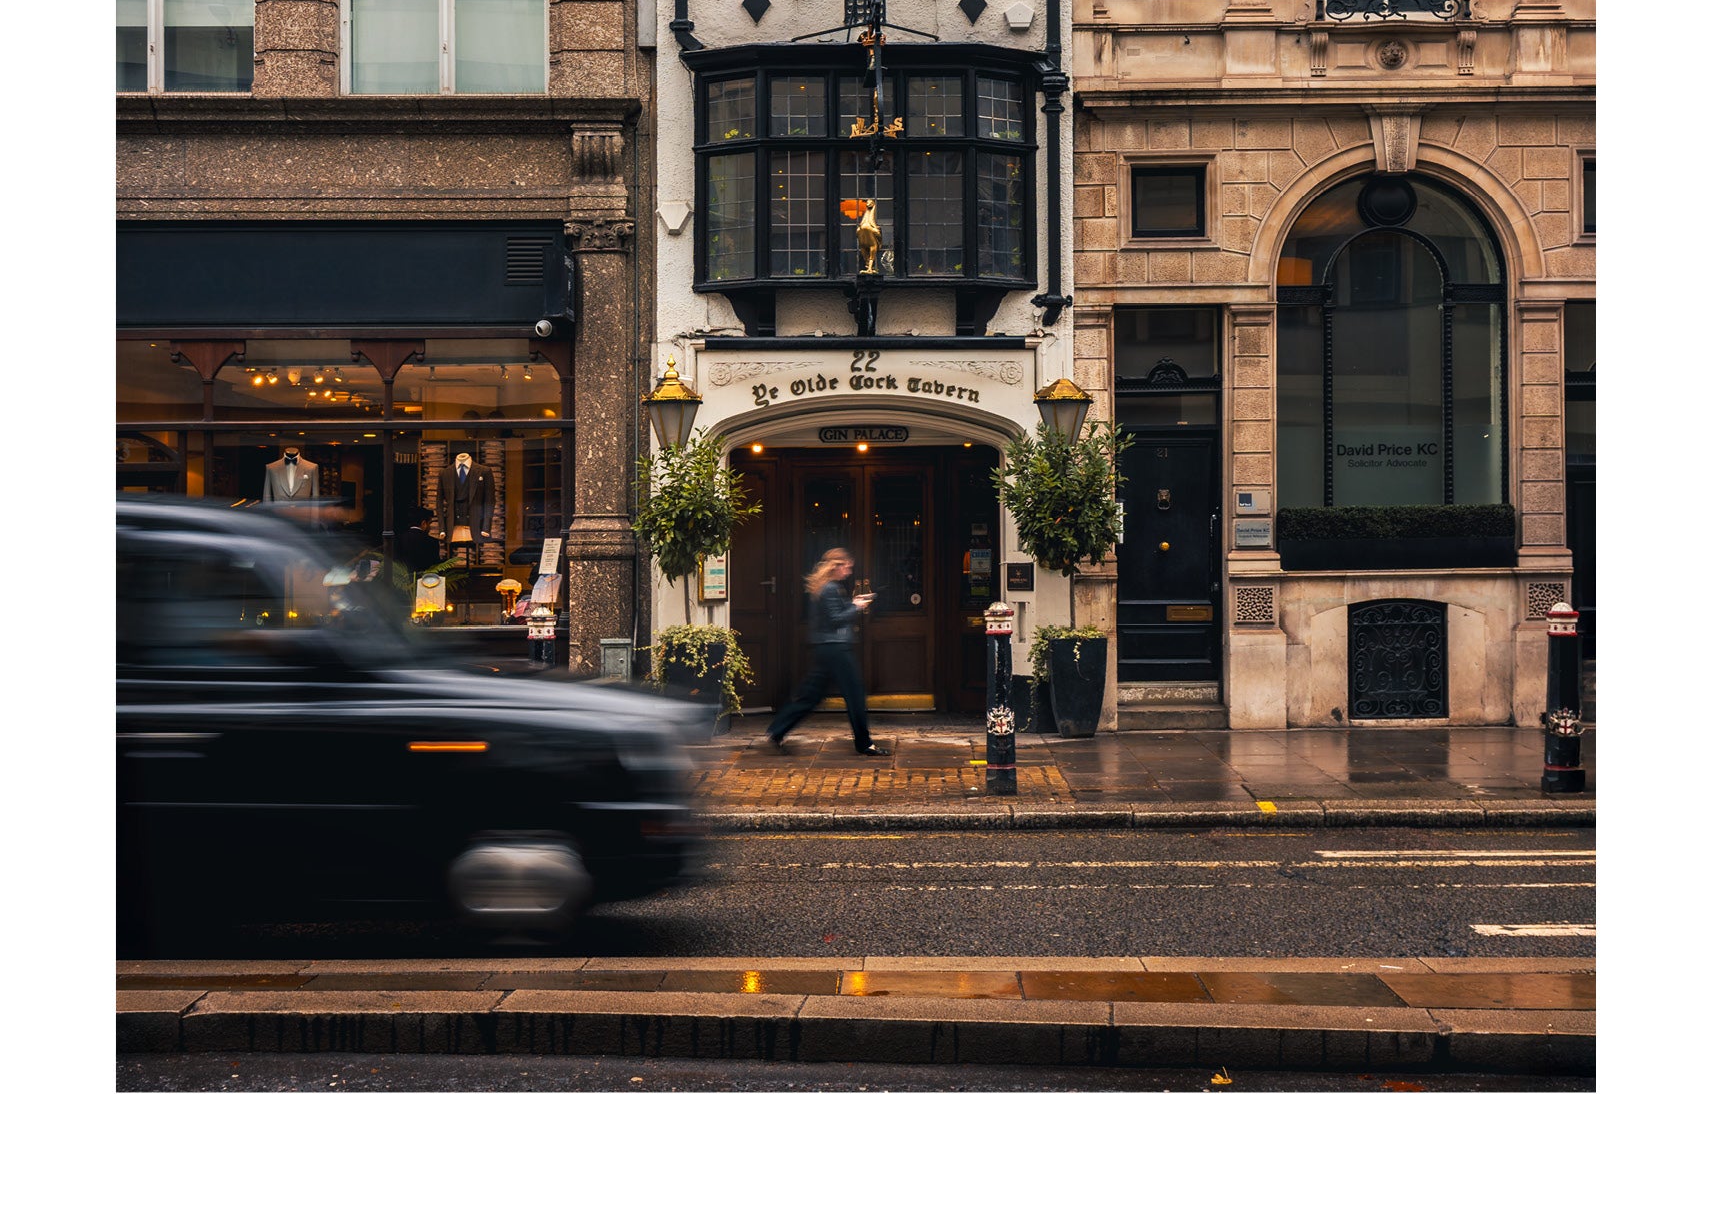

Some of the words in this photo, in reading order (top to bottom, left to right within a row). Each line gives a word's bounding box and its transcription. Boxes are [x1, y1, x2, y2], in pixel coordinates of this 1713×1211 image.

[850, 350, 880, 372] 22
[752, 383, 779, 407] Ye
[790, 373, 839, 396] Olde
[849, 374, 898, 390] Cock
[907, 377, 980, 403] Tavern
[823, 429, 848, 440] GIN
[854, 428, 904, 440] PALACE
[1336, 444, 1374, 456] David
[1378, 443, 1412, 456] Price
[1417, 443, 1438, 456] KC
[1347, 459, 1383, 468] Solicitor
[1386, 459, 1427, 468] Advocate
